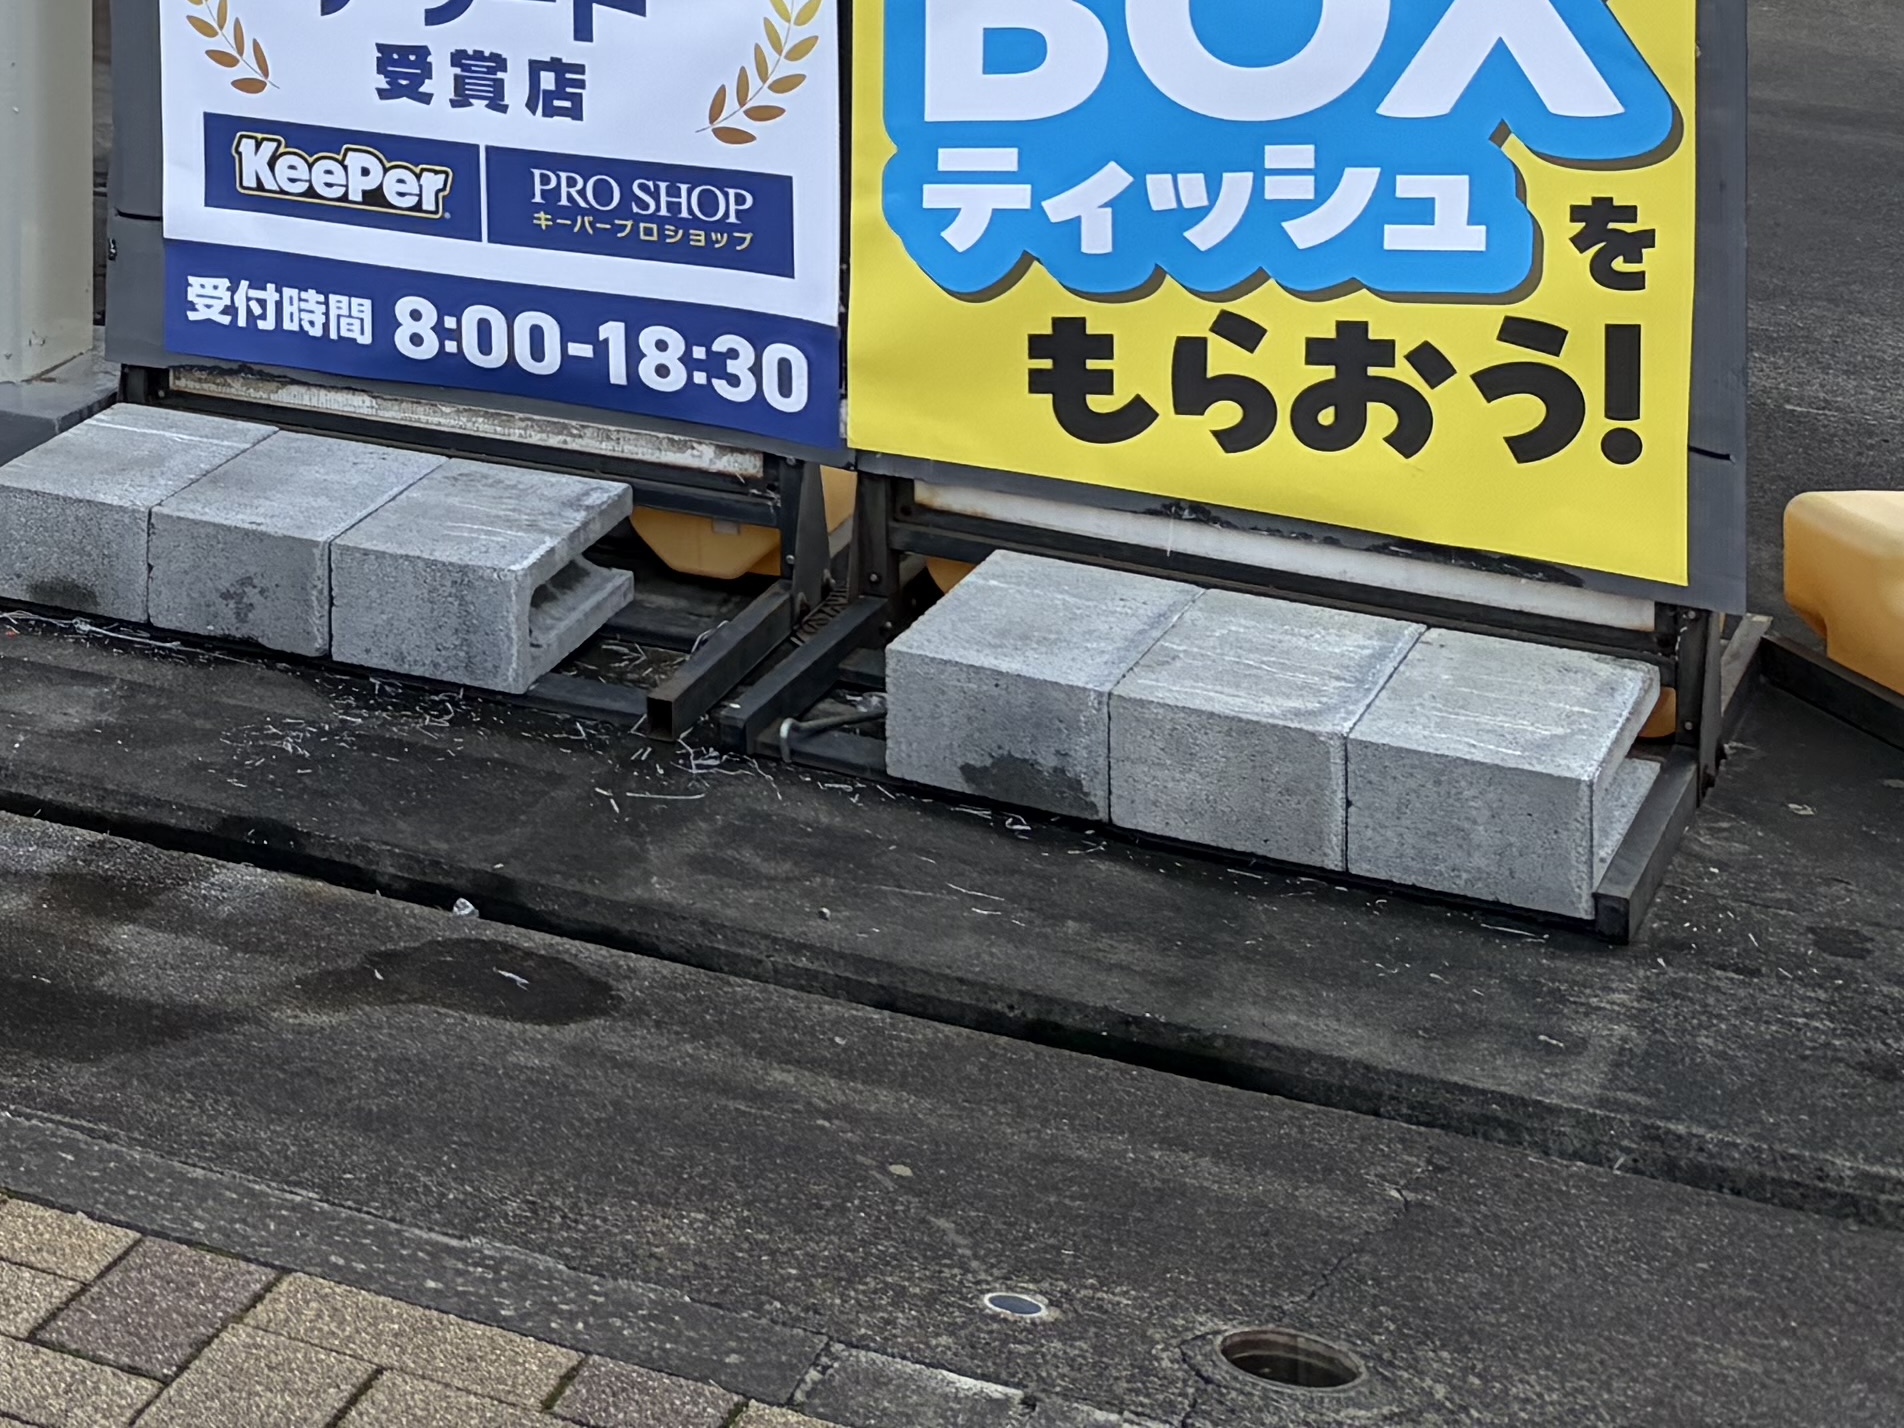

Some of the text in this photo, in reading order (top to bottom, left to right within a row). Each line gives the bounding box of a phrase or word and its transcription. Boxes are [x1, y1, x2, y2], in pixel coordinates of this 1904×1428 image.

[375, 42, 588, 122] 受賞店
[235, 134, 450, 215] KeePer
[530, 168, 754, 226] PRO SHOP
[532, 211, 754, 251] キーパープロショップ
[921, 143, 1657, 292] ティッシュ を
[186, 275, 810, 414] 受付時間 8:00-18:30
[1027, 309, 1643, 466] もらおう!
